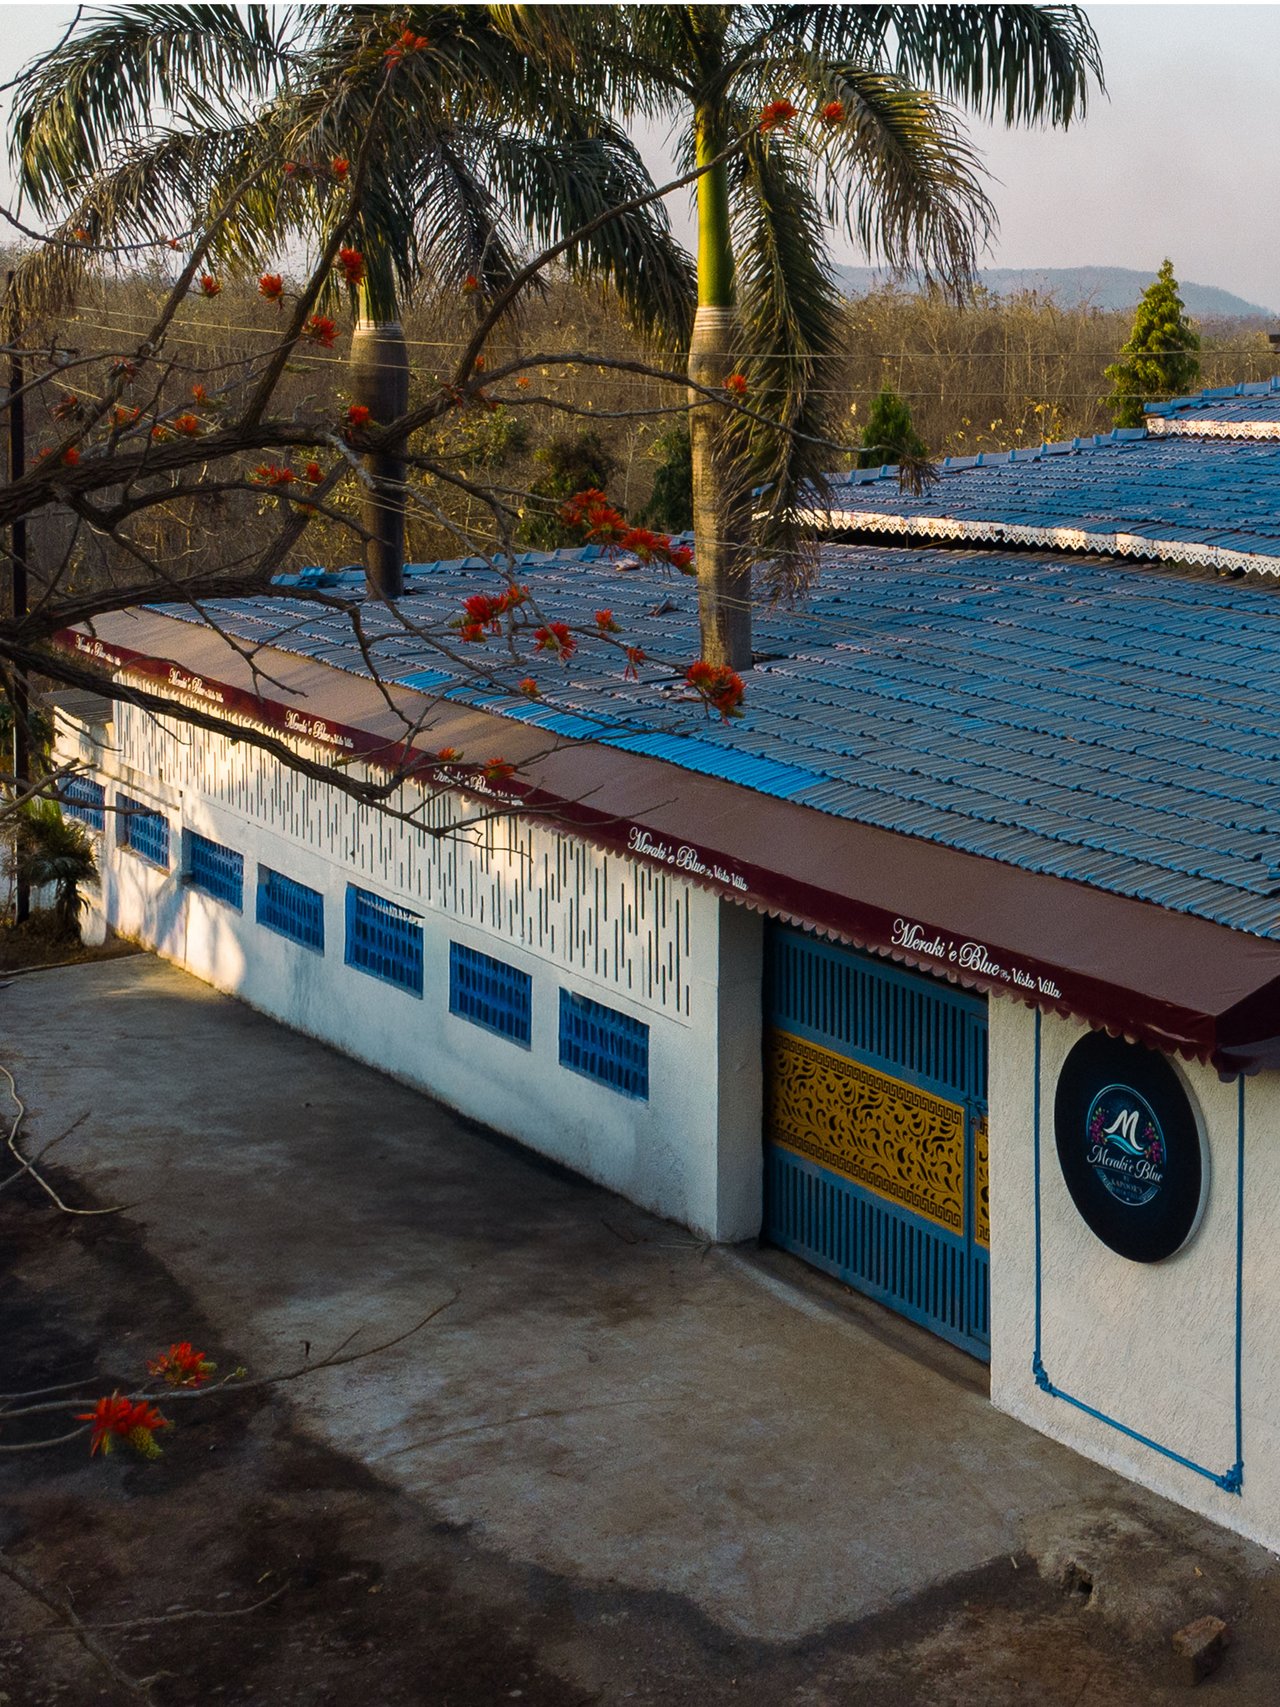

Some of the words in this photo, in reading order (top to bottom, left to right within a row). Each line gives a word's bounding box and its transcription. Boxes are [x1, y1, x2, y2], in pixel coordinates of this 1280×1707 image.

[676, 845, 706, 875] Blue
[958, 942, 1001, 976] Blue
[1011, 967, 1036, 989] Vista
[1037, 976, 1062, 999] Villa
[1103, 1109, 1144, 1151] M
[1134, 1159, 1163, 1183] Blue
